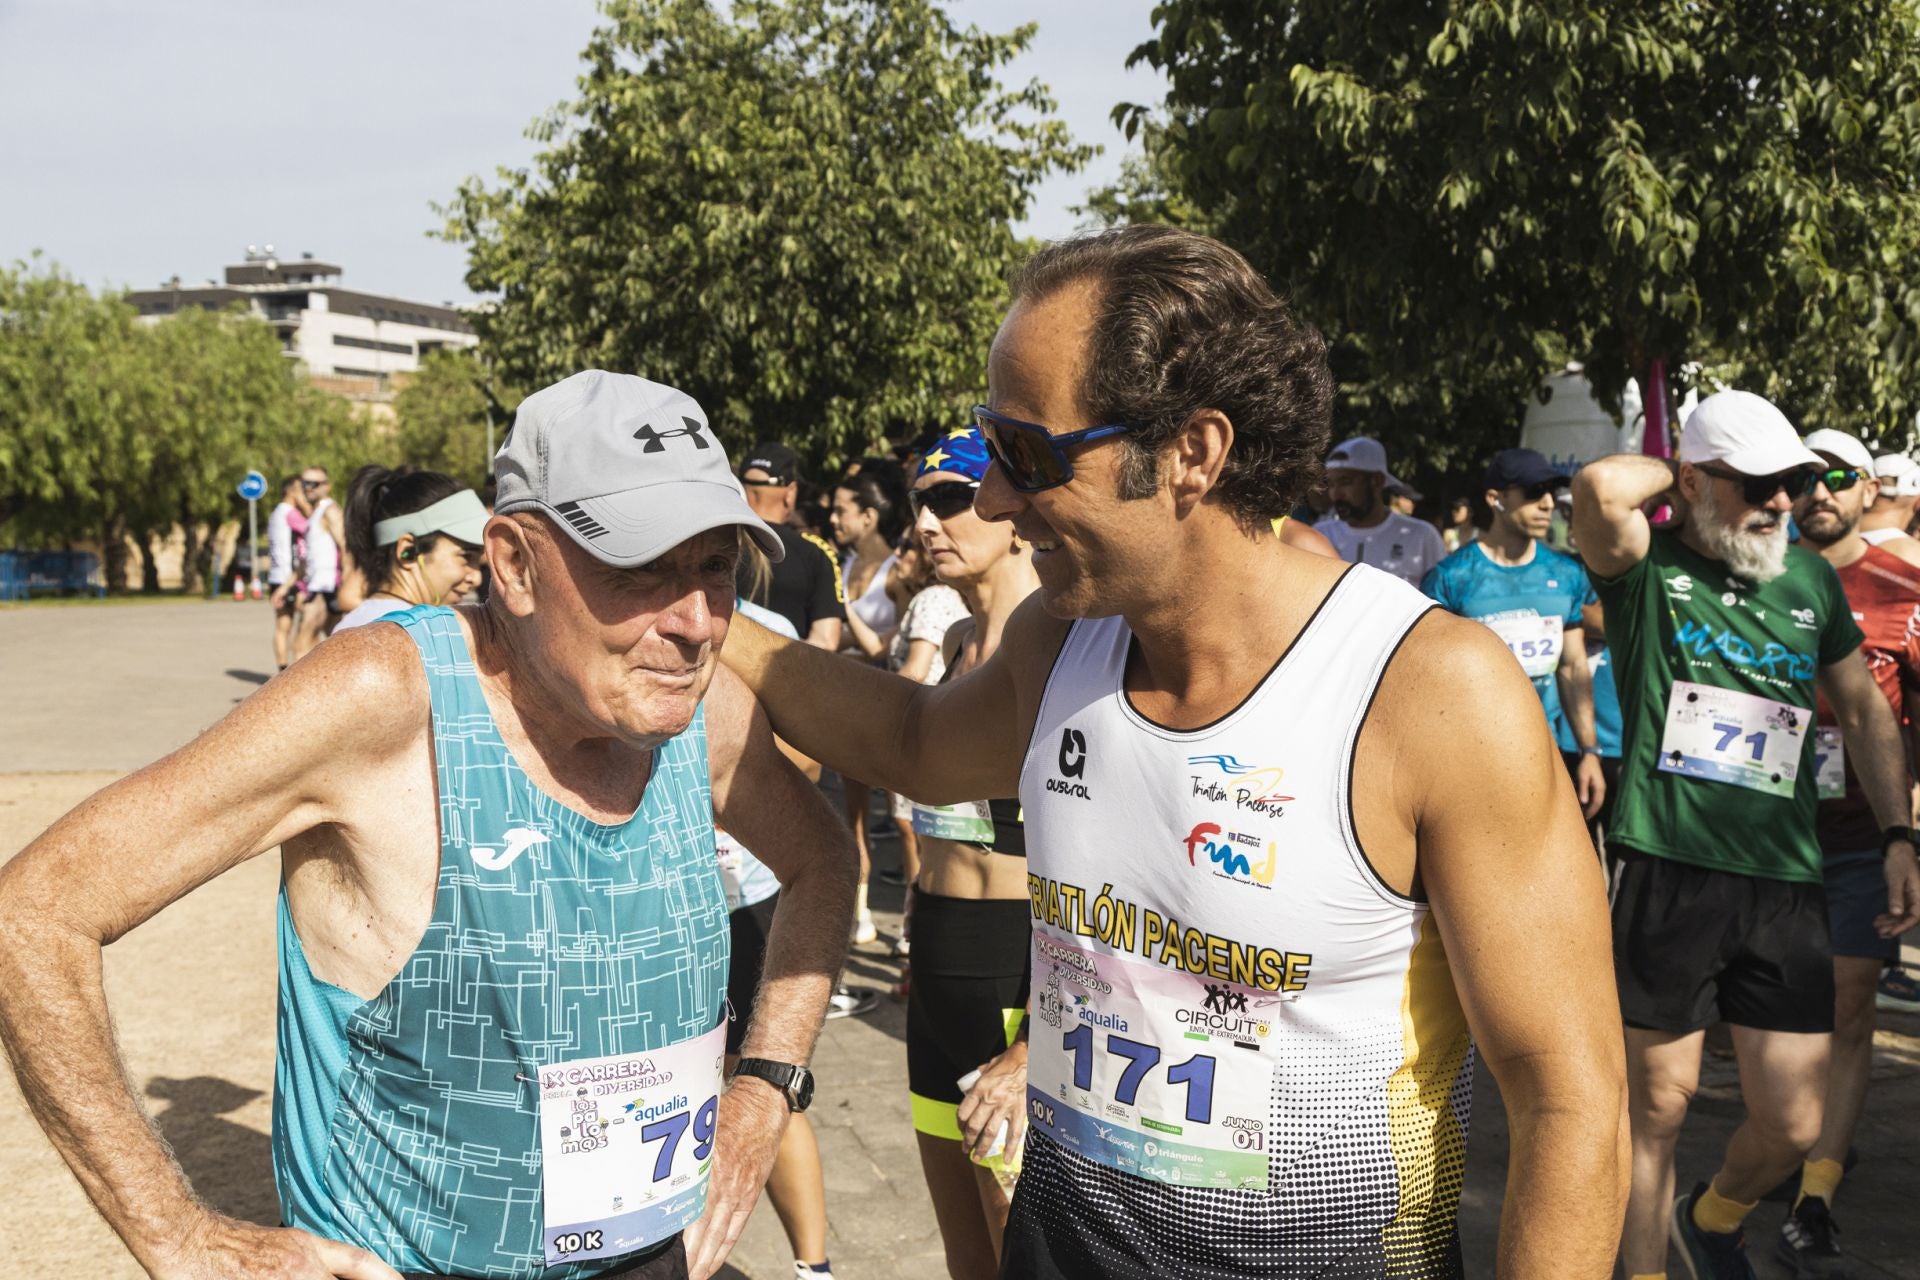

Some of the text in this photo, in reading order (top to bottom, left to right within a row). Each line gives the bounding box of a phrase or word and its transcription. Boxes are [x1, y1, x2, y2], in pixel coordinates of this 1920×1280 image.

[1713, 723, 1768, 761] 71
[1046, 778, 1091, 801] austral
[1047, 942, 1098, 976] CARRERA
[1143, 908, 1312, 992] PACENSE
[1059, 966, 1112, 995] DIVERSIDAD
[1079, 1006, 1128, 1033] aqualia
[1189, 1025, 1205, 1034] JUNTA
[1216, 1031, 1257, 1044] EXTREMADURA
[542, 1058, 656, 1089] IX CARRERA
[593, 1071, 673, 1097] DIVERSIDAD
[1063, 1023, 1217, 1125] 171
[571, 1100, 598, 1112] l@s
[634, 1095, 688, 1122] aqualia
[1031, 1098, 1055, 1128] 10 K
[572, 1110, 599, 1130] pa
[580, 1122, 602, 1138] lo
[1222, 1116, 1263, 1131] JUNIO
[561, 1136, 608, 1154] m@s
[641, 1094, 718, 1183] 79
[1233, 1129, 1263, 1151] 01
[554, 1229, 603, 1254] 10 K
